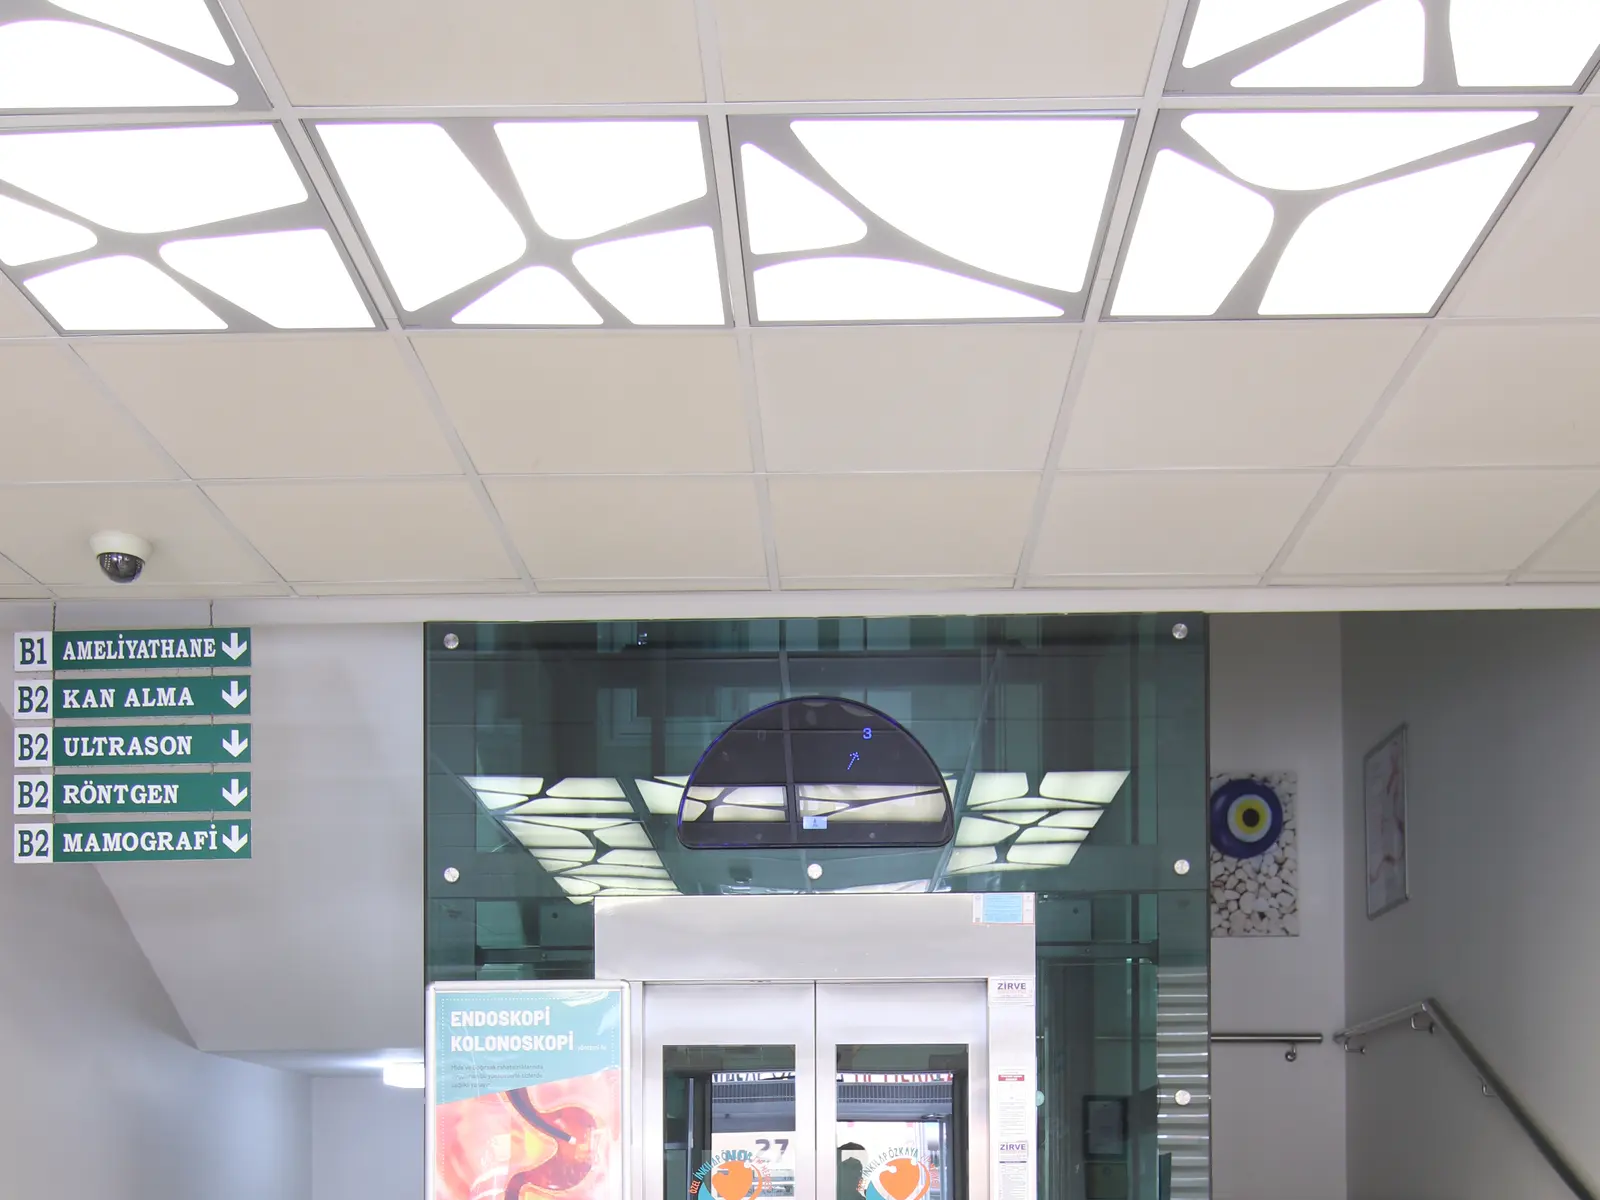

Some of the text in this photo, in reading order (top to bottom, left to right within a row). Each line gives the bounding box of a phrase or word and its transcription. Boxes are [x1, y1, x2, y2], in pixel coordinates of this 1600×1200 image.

[20, 634, 216, 665] B1 AMELİYATHANE
[18, 686, 194, 713] B2 KAN ALMA
[862, 727, 873, 740] 3
[18, 733, 193, 761] B2 ULTRASON
[18, 780, 179, 808] B2 RÖNTGEN
[18, 824, 217, 857] B2 MAMOGRAFİ
[997, 981, 1026, 990] ZİRVE
[451, 1005, 550, 1027] ENDOSKOPİ
[451, 1030, 574, 1052] KOLONOSKOPİ
[1000, 1142, 1026, 1151] ZİRVE
